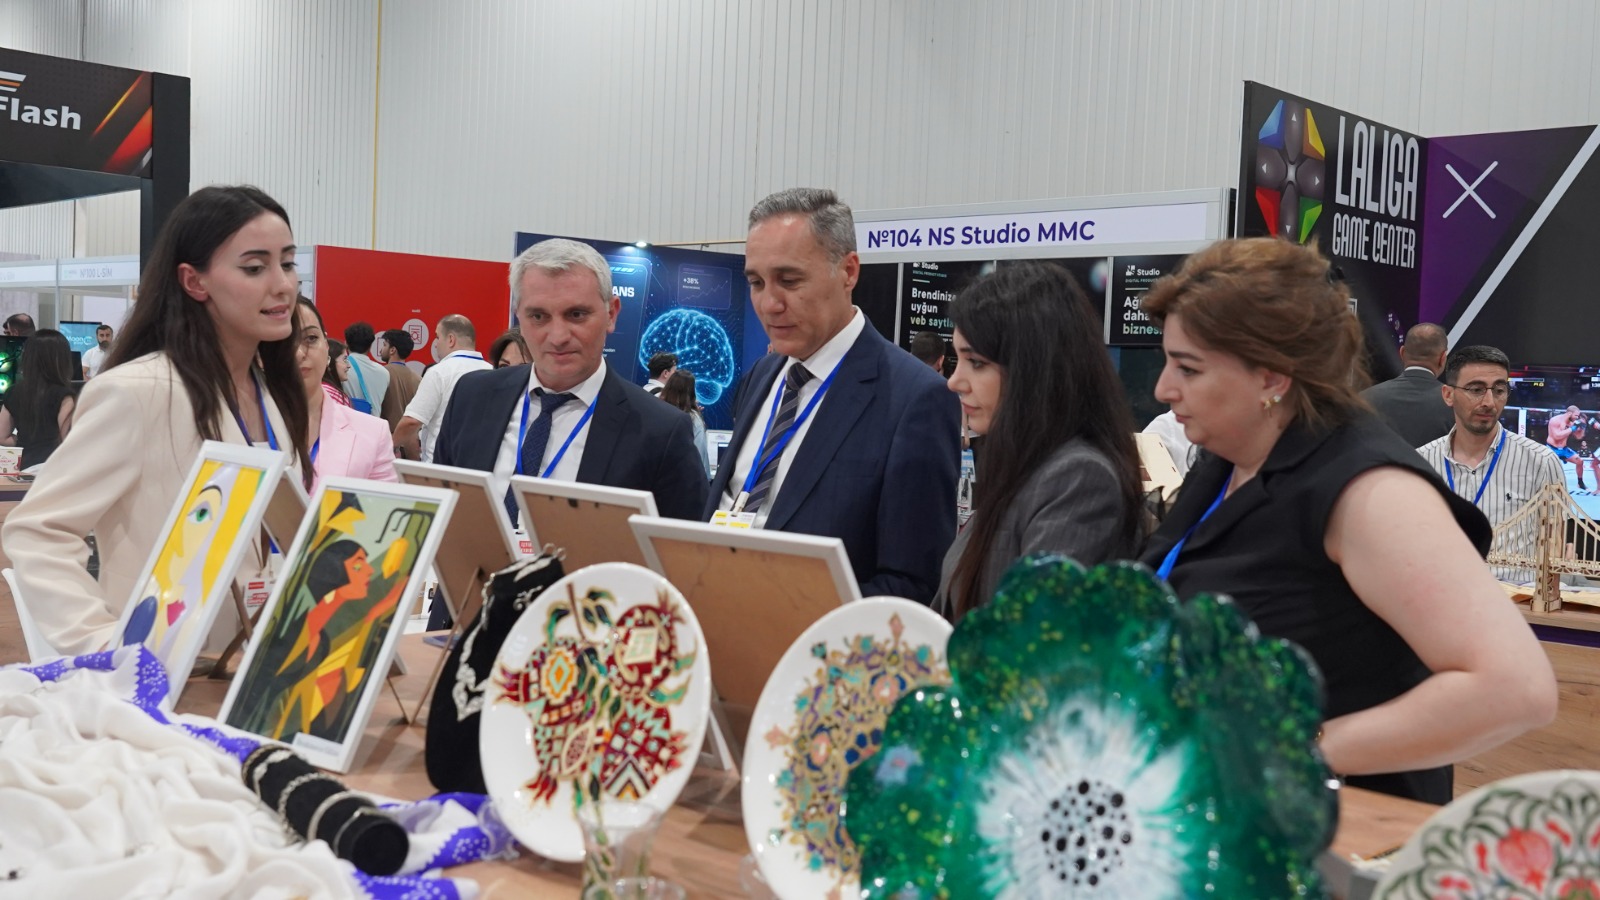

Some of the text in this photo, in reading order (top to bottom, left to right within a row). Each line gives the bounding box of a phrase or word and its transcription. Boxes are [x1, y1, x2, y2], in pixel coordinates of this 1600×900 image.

[1335, 115, 1420, 221] LALIGA
[928, 227, 955, 246] NS
[961, 222, 1030, 245] Studio
[1038, 220, 1095, 242] MMC
[1332, 212, 1416, 269] GAME CENTER
[1137, 268, 1160, 276] Studio
[911, 302, 938, 314] uyğun
[910, 315, 926, 326] veb
